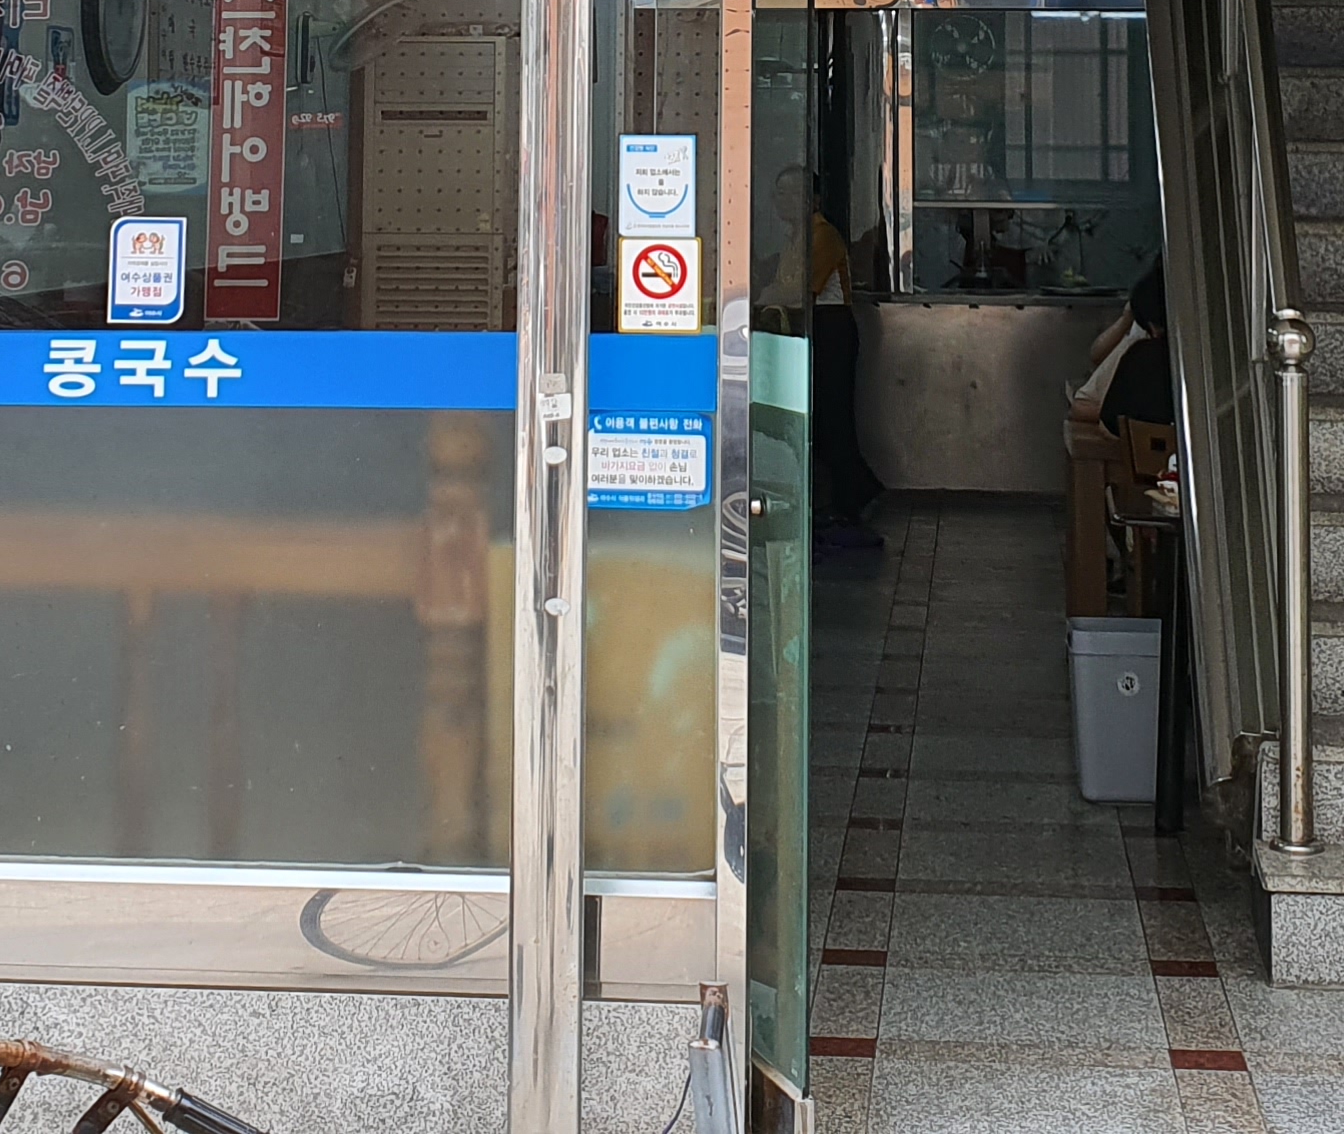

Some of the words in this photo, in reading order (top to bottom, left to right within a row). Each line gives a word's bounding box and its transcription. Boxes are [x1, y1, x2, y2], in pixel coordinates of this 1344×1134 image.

[120, 272, 173, 284] 여수상품권
[130, 286, 162, 298] 가맹점
[43, 338, 243, 398] 콩국수
[605, 417, 635, 429] 이용객
[638, 417, 679, 431] 불편사항
[682, 418, 703, 431] 전화
[591, 447, 609, 458] 우리
[611, 447, 639, 459] 업소는
[601, 460, 645, 472] 바가지요금
[669, 462, 687, 473] 손님
